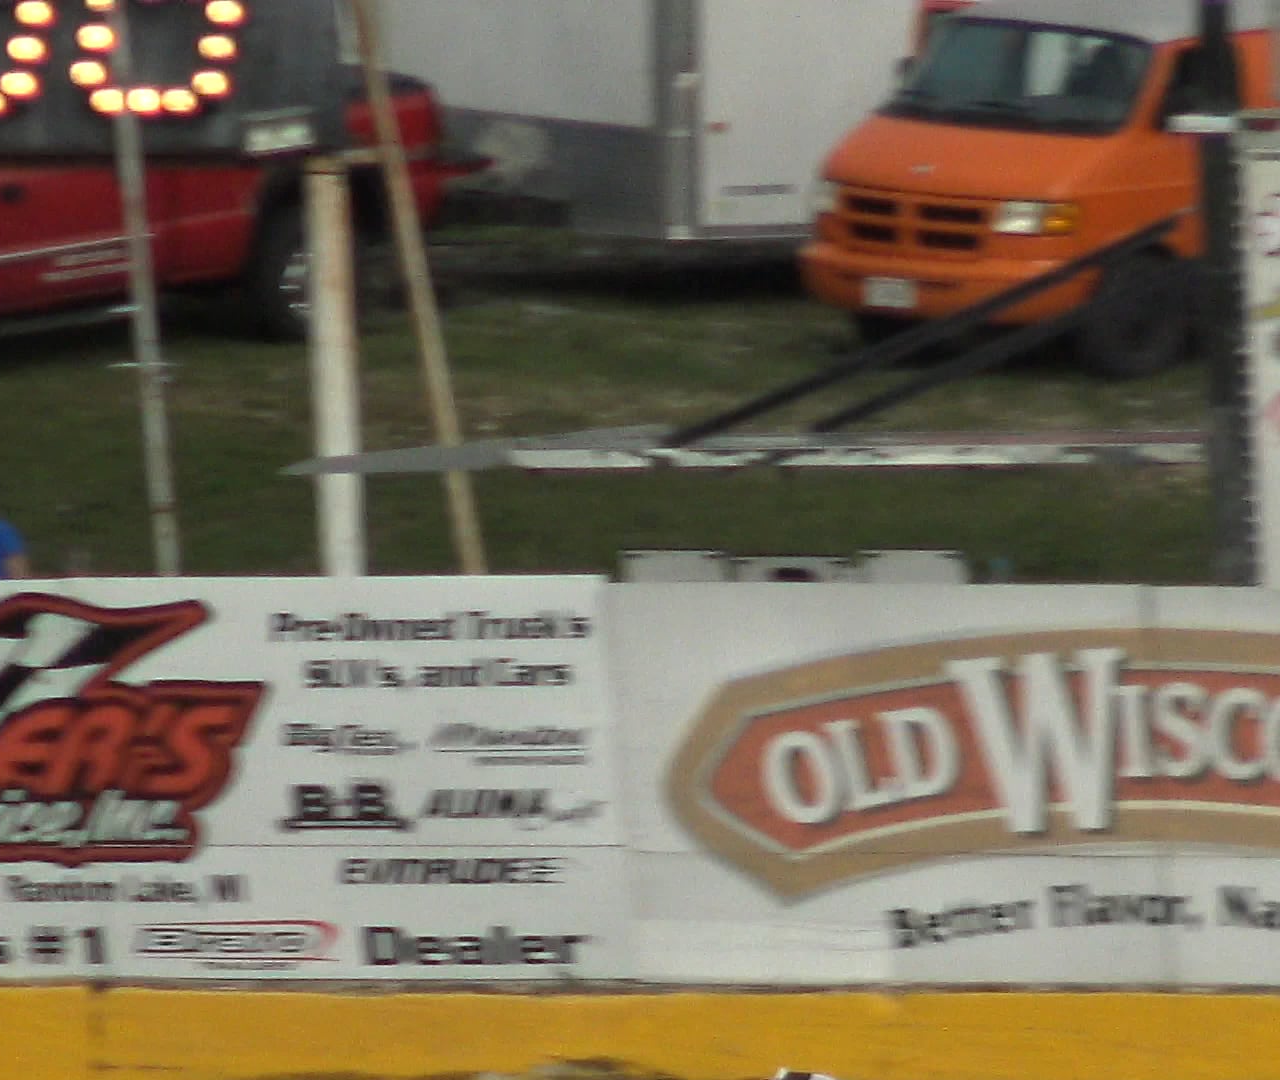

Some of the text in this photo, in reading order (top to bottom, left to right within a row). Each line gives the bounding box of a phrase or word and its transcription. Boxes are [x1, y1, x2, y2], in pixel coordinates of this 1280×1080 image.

[417, 659, 482, 688] and
[486, 658, 574, 687] Cars
[760, 706, 962, 826] OLD
[363, 925, 590, 965] Dealer
[886, 896, 1035, 949] Better
